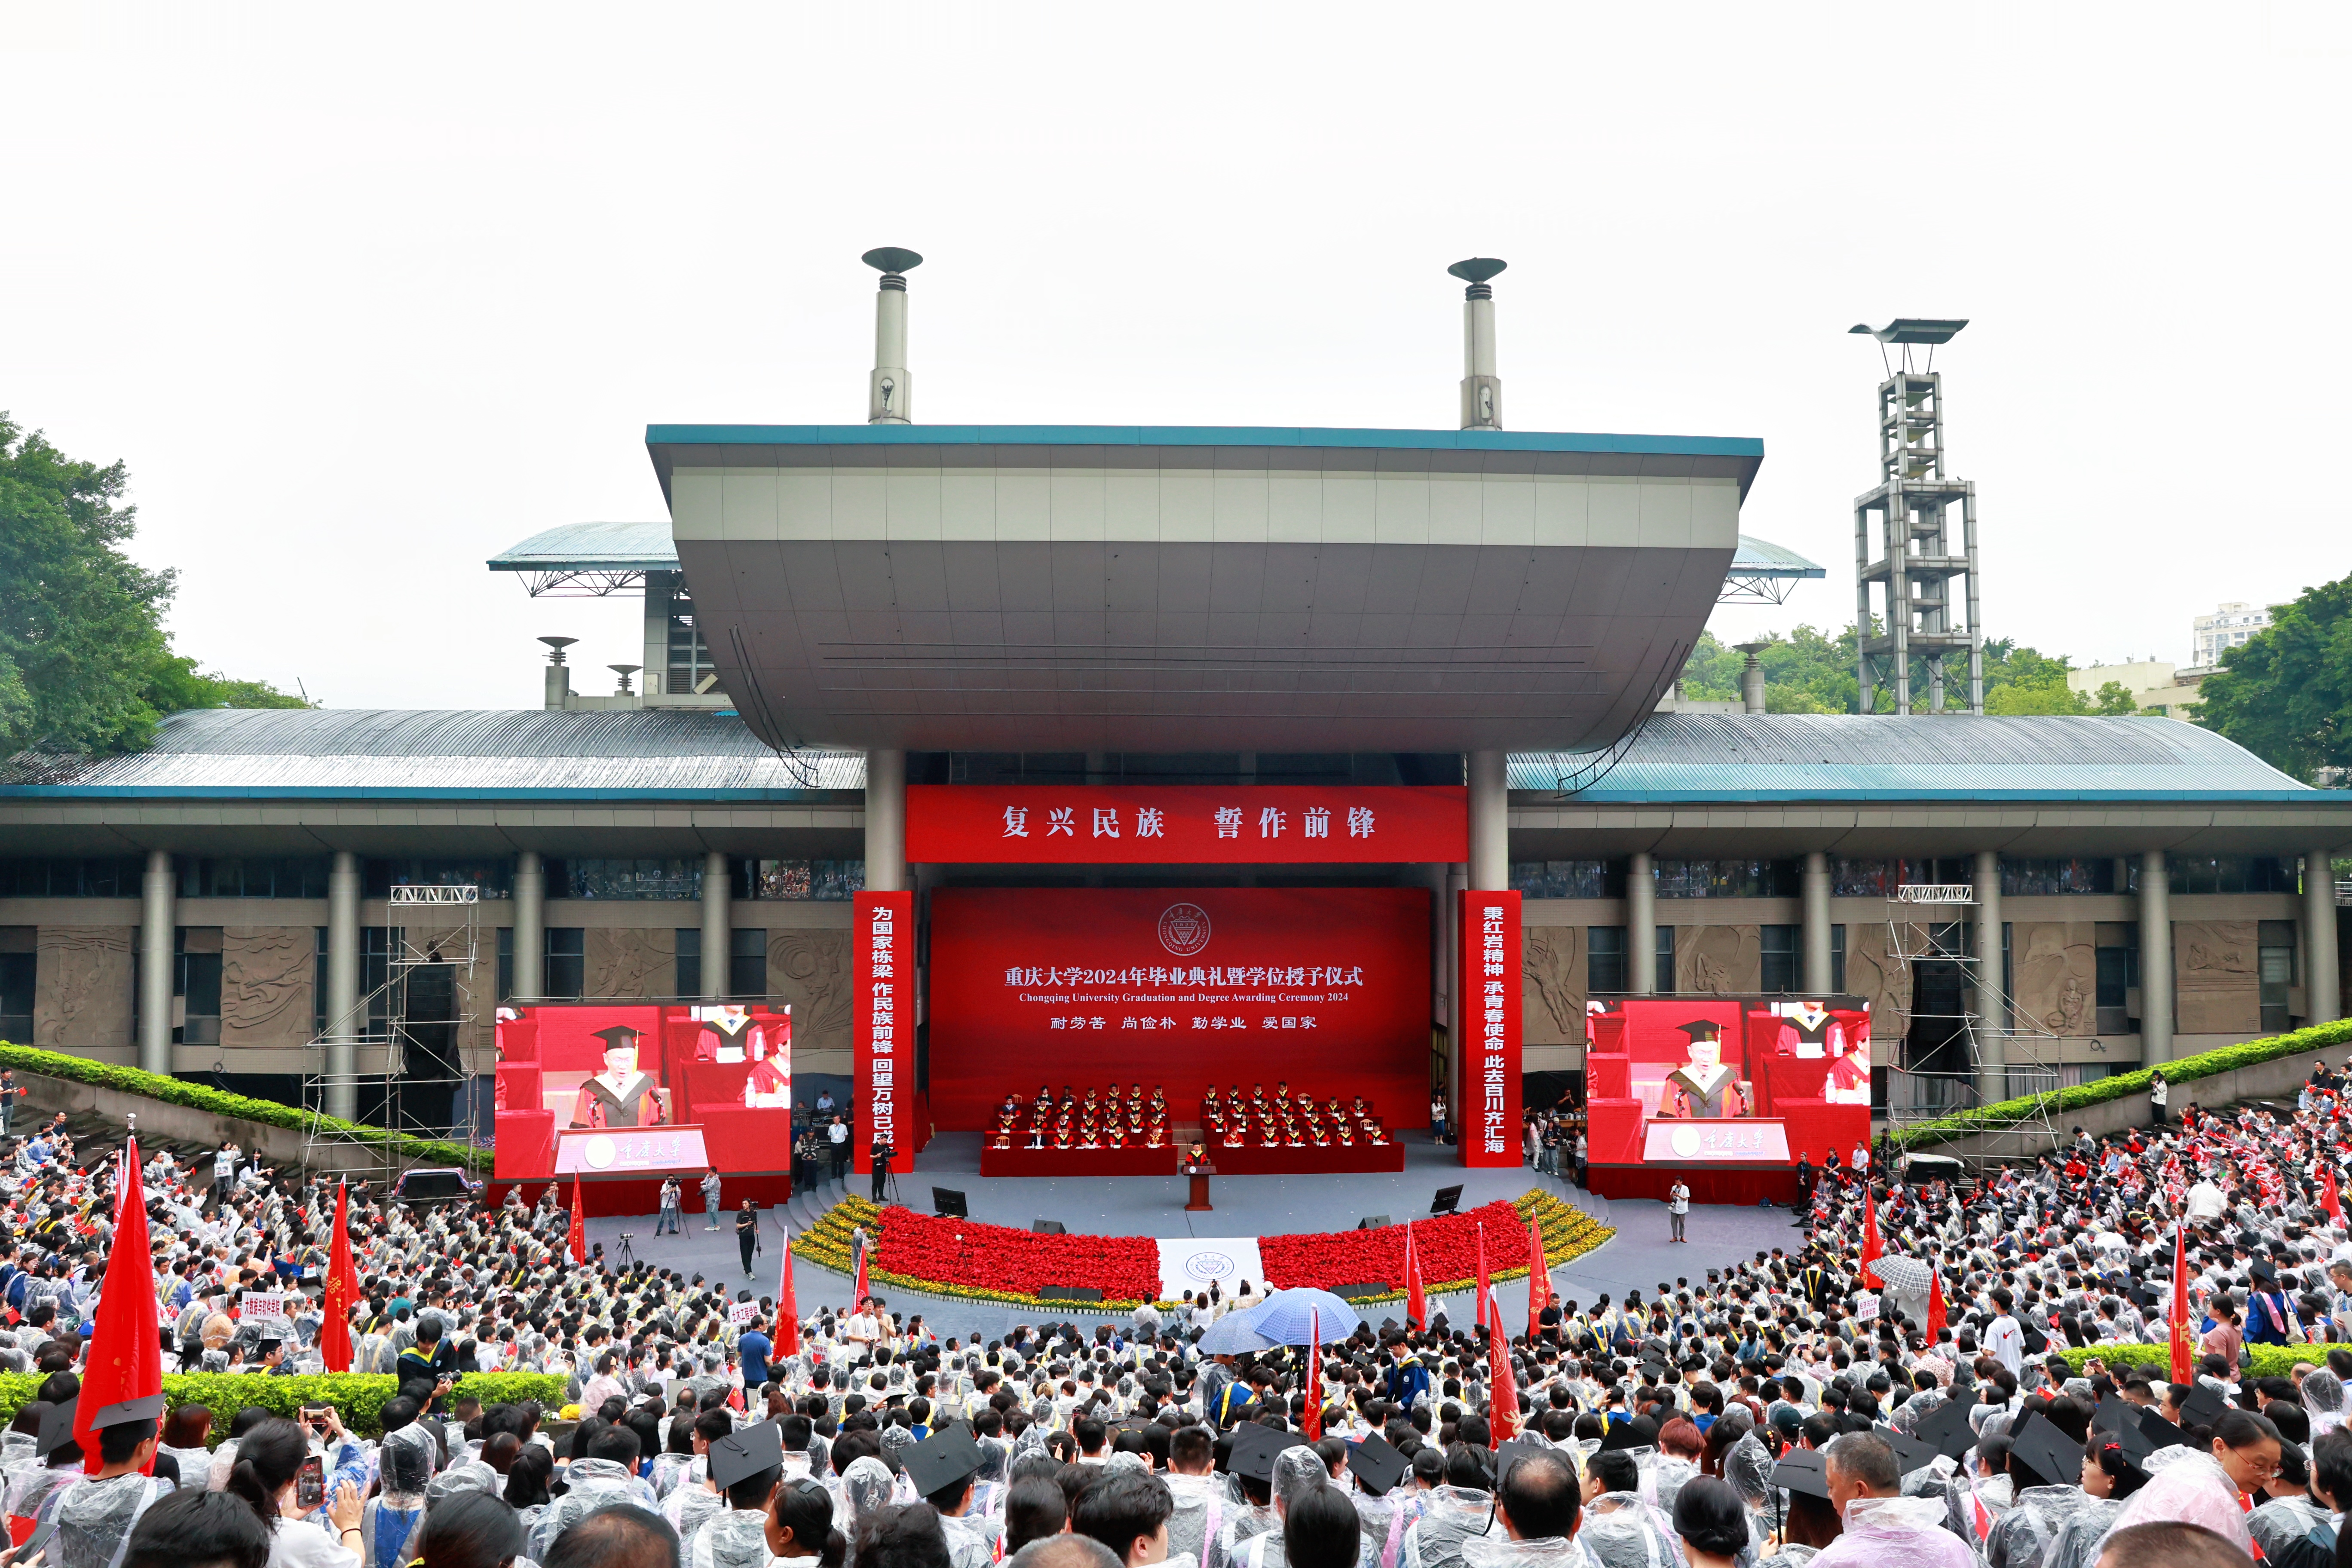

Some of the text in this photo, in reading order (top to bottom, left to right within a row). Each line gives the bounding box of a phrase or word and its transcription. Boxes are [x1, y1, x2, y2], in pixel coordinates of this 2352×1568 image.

[1002, 805, 1375, 839] 复兴民族 誓作前锋
[1004, 966, 1363, 987] 重庆大学2024年毕业典礼暨学位授予仪式
[1019, 992, 1348, 1004] Chongqing University Graduation and Degree Awarding Ceremony 2024
[872, 906, 894, 1150] 为国家栋梁 作民族前锋 回望万树已成
[1050, 1016, 1317, 1029] 耐劳苦 尚俭朴 勤学业 爱国家
[1483, 906, 1505, 1153] 秉红岩精神 承青春使命 此去百川齐汇海
[245, 1297, 280, 1317] 大数据与软件学院
[1860, 1298, 1877, 1310] 经济与工商
[1862, 1308, 1876, 1318] 管理学院
